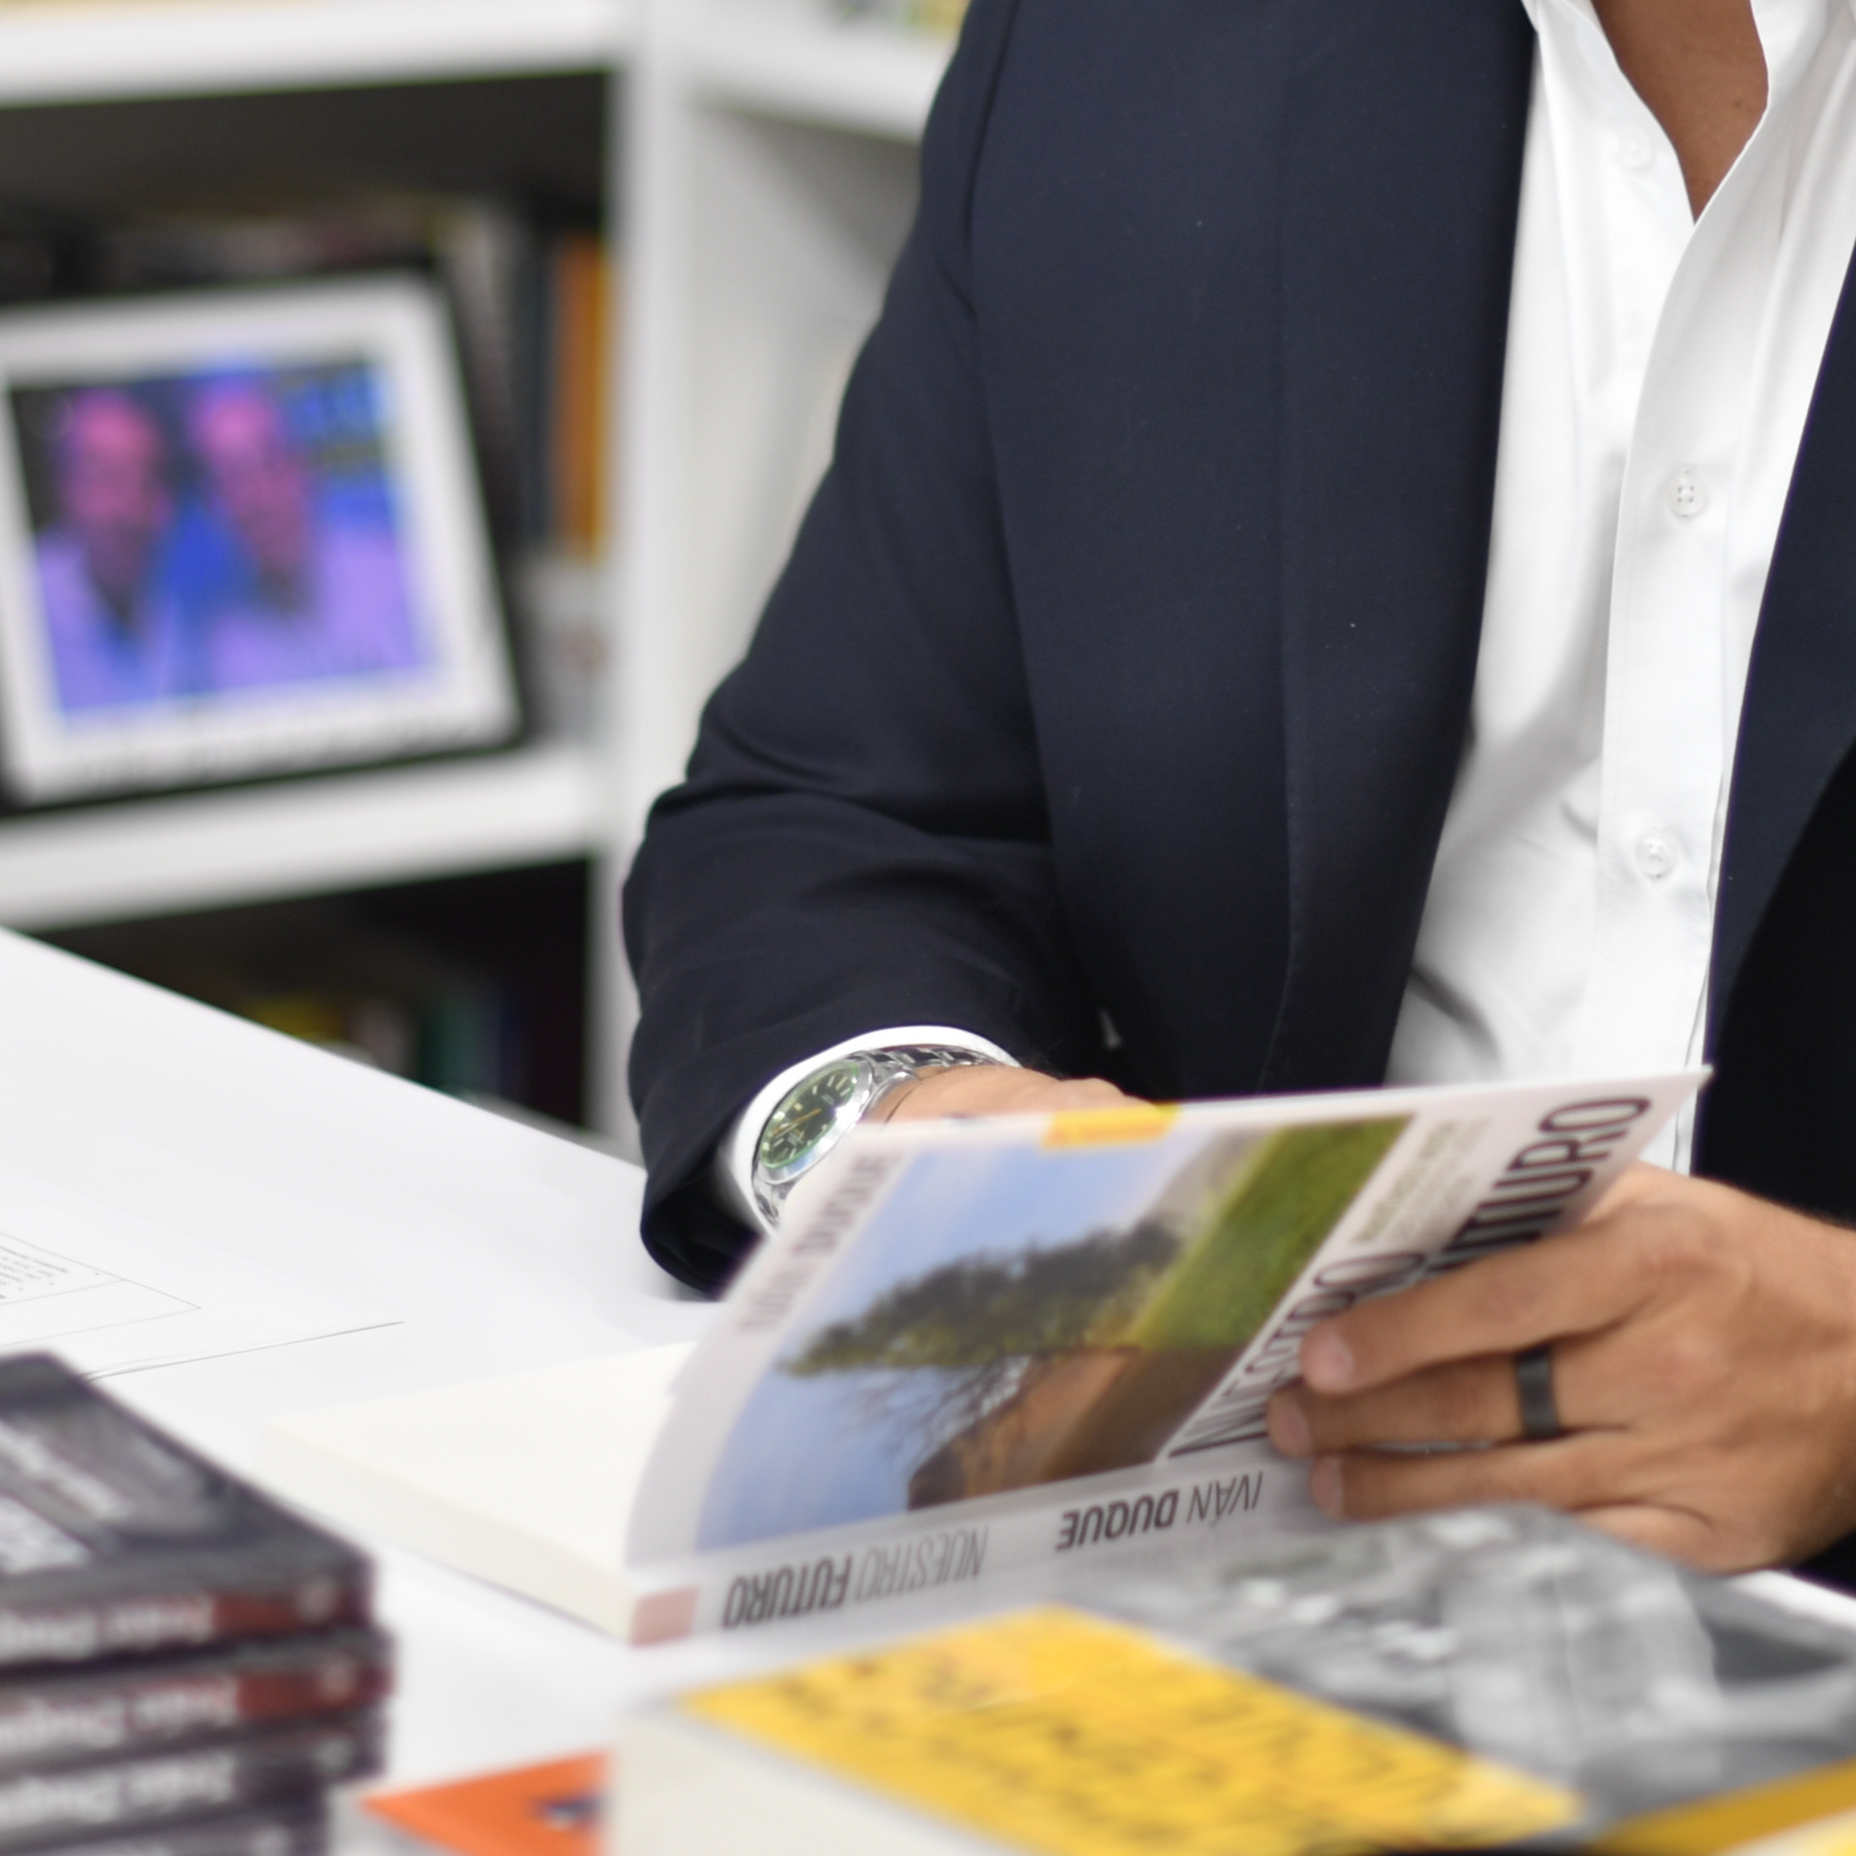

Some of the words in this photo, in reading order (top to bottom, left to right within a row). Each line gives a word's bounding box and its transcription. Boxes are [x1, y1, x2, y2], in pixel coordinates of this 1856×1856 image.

[1055, 1488, 1180, 1552] DUQUE
[1187, 1471, 1264, 1529] IVÁN
[722, 1553, 852, 1631] FUTURO
[855, 1524, 992, 1604] NUESTRO
